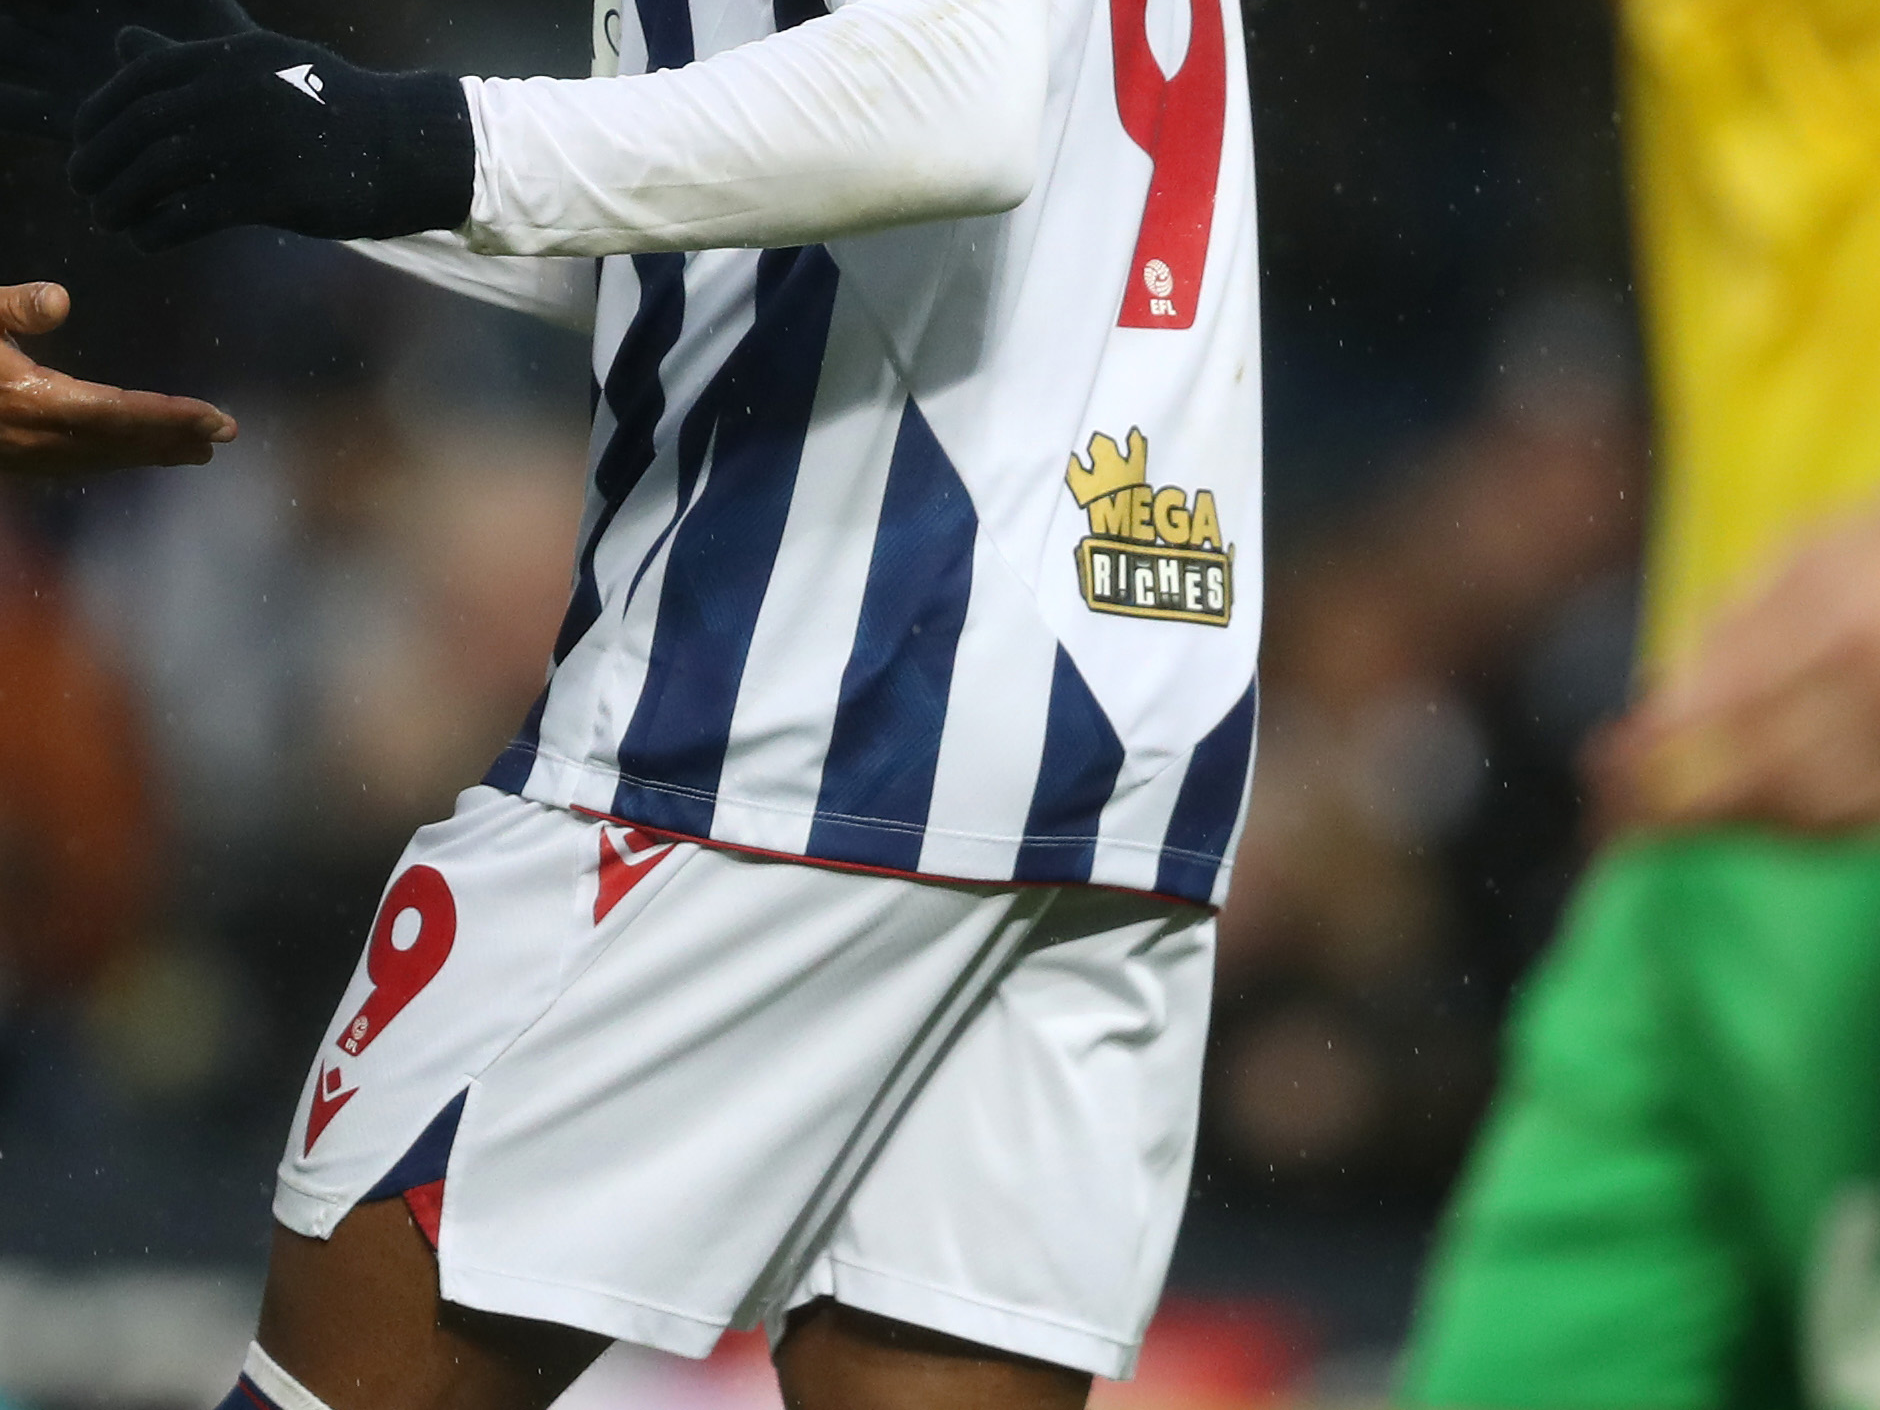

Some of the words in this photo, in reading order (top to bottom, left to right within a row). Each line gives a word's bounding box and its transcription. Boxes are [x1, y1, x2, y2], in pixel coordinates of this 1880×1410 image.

[1150, 298, 1177, 316] EFL
[1087, 483, 1223, 553] MEGA
[1092, 552, 1224, 611] RICHES
[335, 863, 458, 1057] 9
